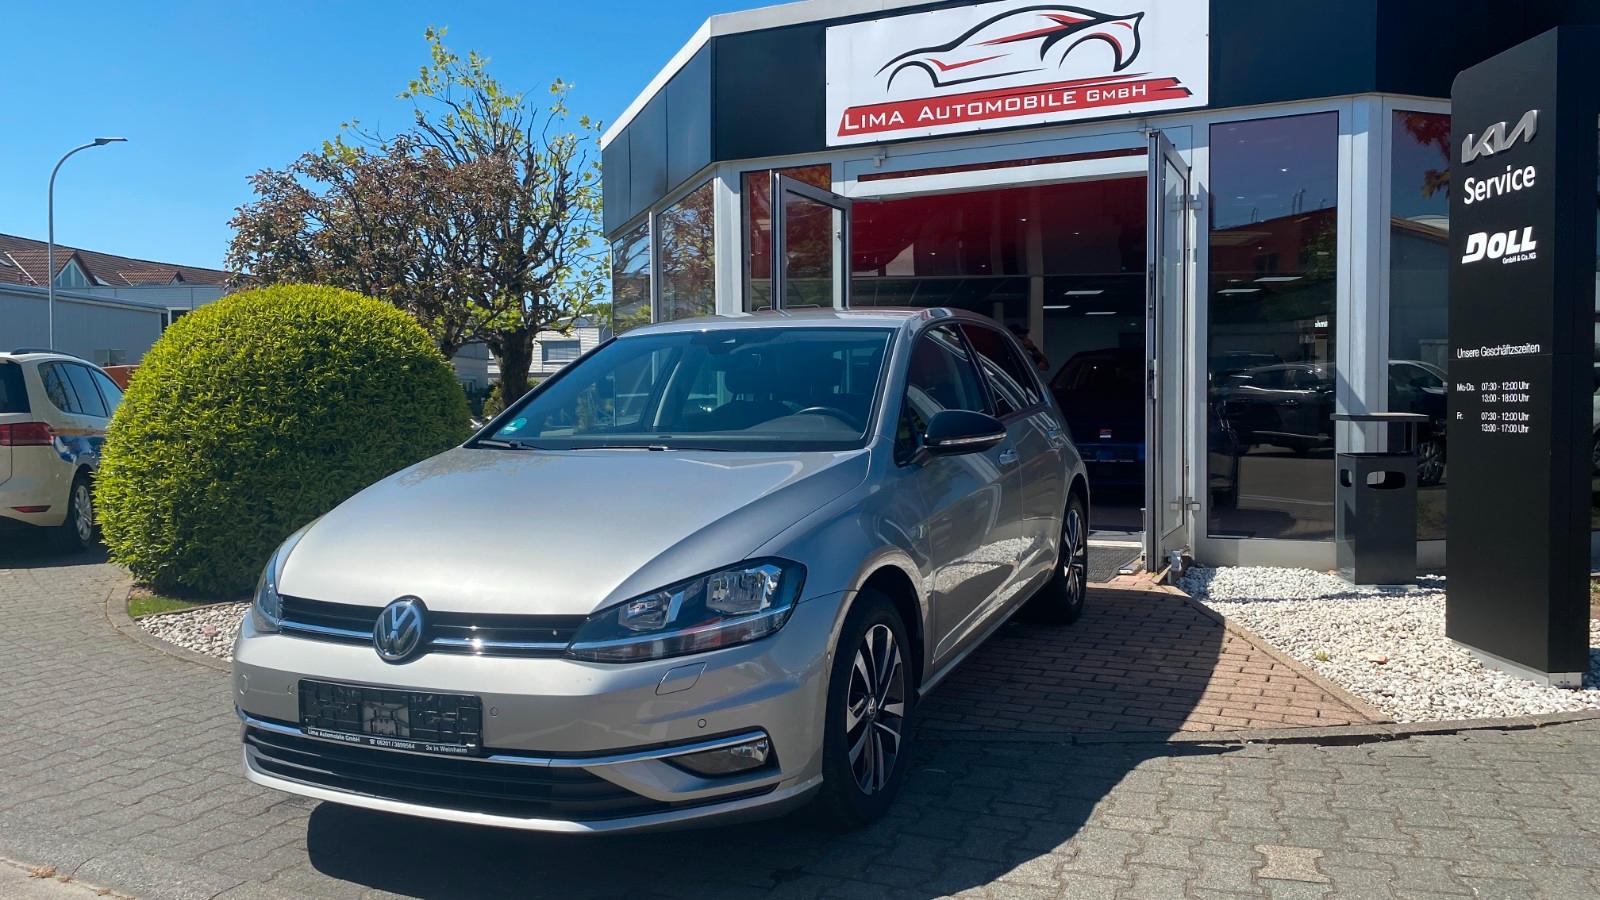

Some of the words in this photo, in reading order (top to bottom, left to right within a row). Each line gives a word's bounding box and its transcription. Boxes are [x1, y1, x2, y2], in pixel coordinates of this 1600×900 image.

[844, 111, 905, 130] LIMA
[917, 91, 1078, 122] AUTOMOBILE
[1461, 109, 1538, 164] KIA
[1463, 164, 1536, 205] Service
[1461, 226, 1537, 264] DOLL
[1457, 348, 1480, 358] Unsere
[1481, 382, 1497, 391] 07:30
[1502, 382, 1518, 391] 12:00
[1518, 381, 1530, 390] Uhr
[1481, 394, 1497, 403] 13:00
[1502, 394, 1518, 403] 18:00
[1518, 393, 1530, 402] Uhr
[1456, 412, 1464, 420] Fr.
[1481, 412, 1497, 421] 07:30
[1502, 412, 1518, 421] 12:00
[1518, 412, 1530, 421] Uhr
[1481, 424, 1497, 432] 13:00
[1501, 424, 1517, 433] 17:00
[1517, 424, 1529, 433] Uhr
[345, 735, 361, 743] GmbH
